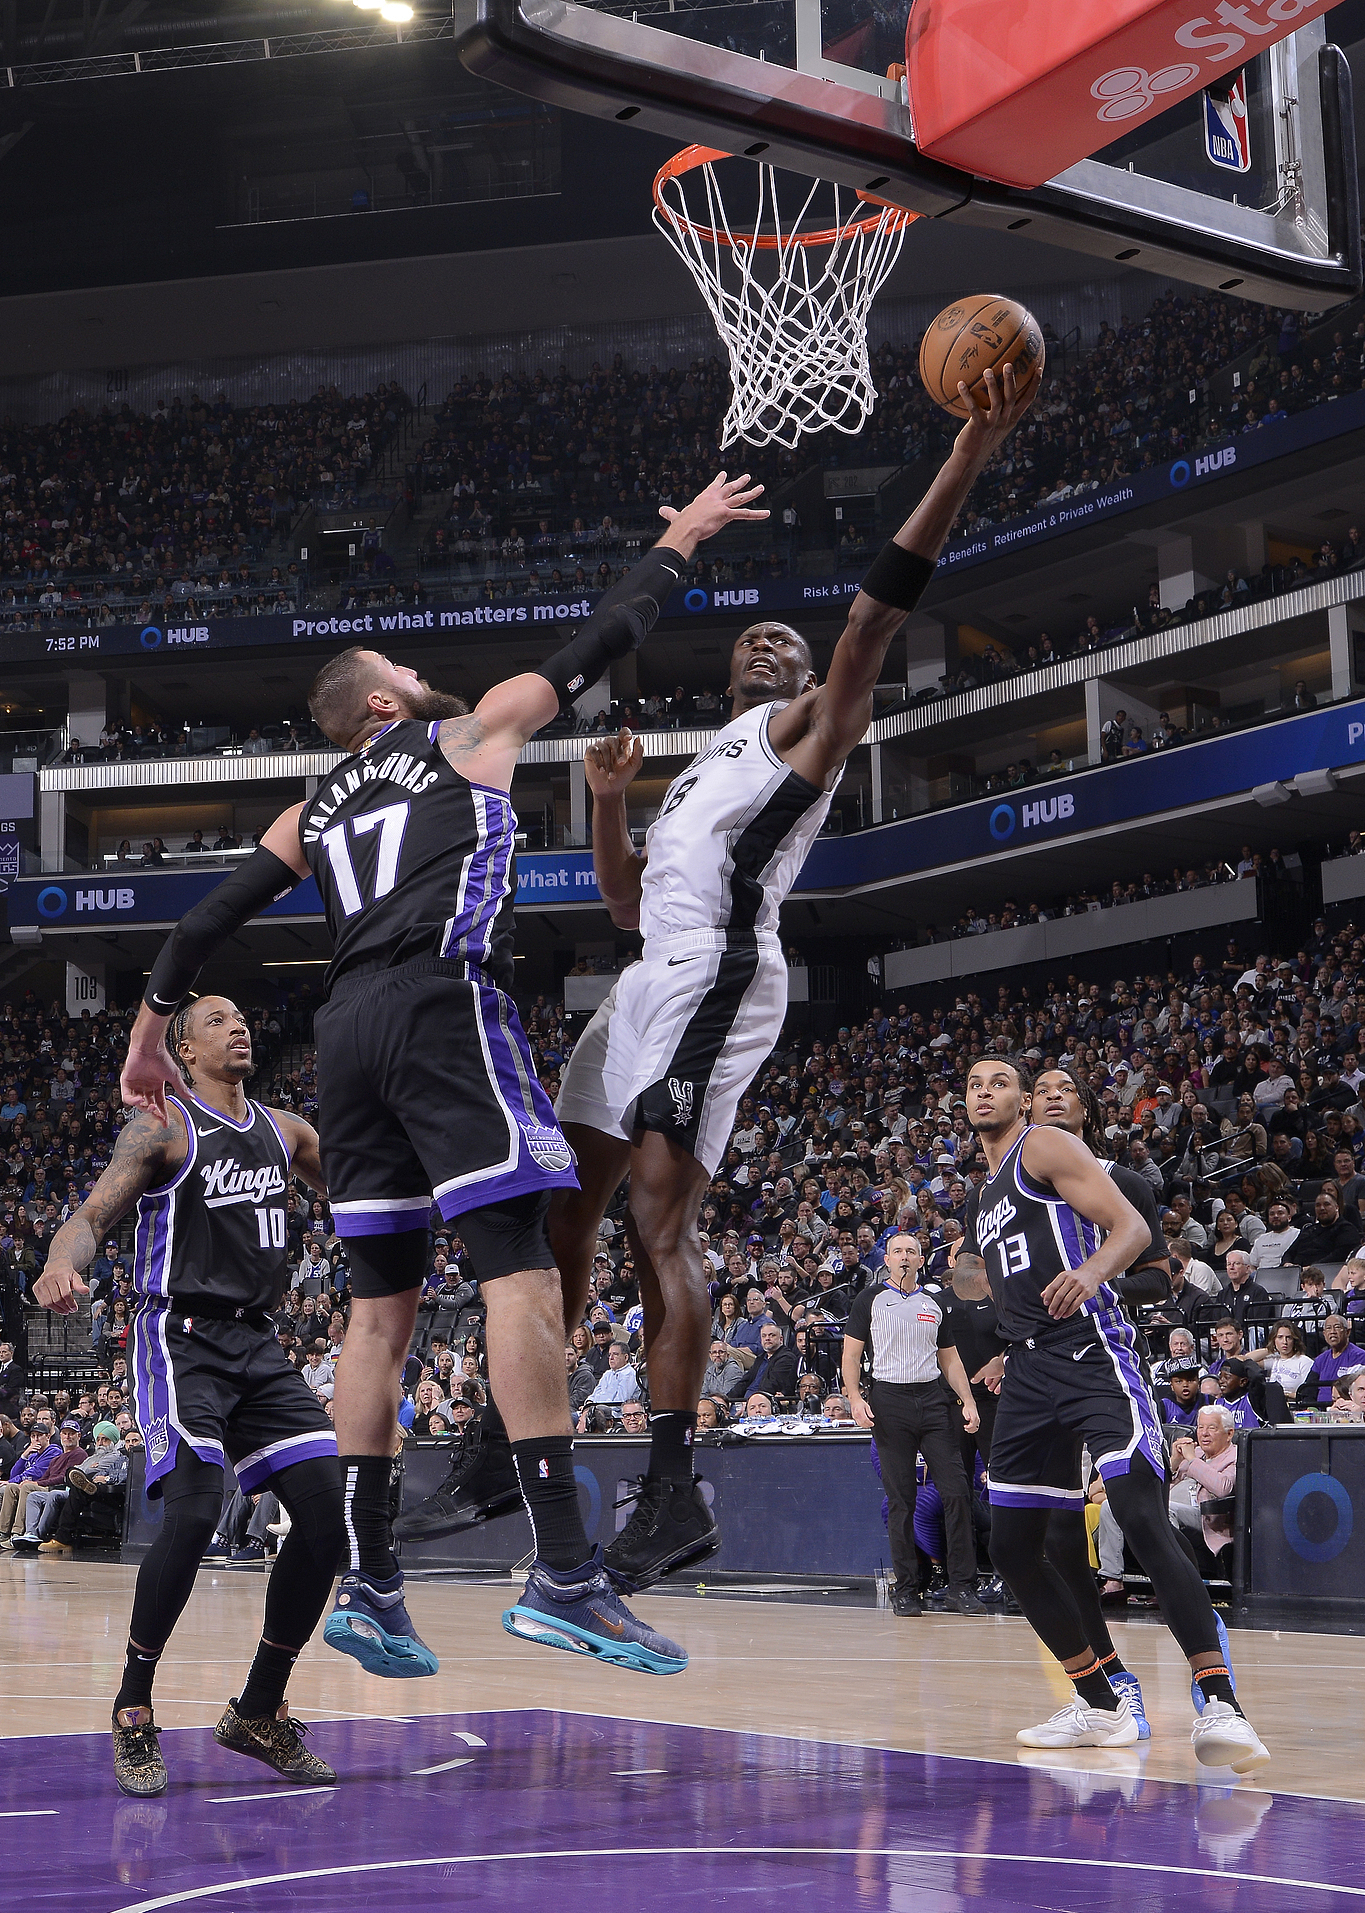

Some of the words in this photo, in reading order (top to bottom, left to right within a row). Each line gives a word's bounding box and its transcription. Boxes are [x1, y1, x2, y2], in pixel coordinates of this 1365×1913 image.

[1212, 134, 1235, 161] NBA
[1195, 446, 1237, 477] HUB
[994, 518, 1047, 547] Retirement
[1049, 514, 1057, 527] &
[1059, 502, 1094, 523] Private
[1096, 487, 1134, 509] Wealth
[949, 541, 987, 563] Benefits
[714, 589, 760, 607] HUB
[803, 586, 829, 599] Risk
[832, 584, 841, 596] &
[292, 615, 373, 637] Protect
[379, 610, 434, 631] what
[440, 606, 528, 627] matters
[45, 637, 75, 652] 7:52
[79, 635, 100, 649] PM
[167, 626, 210, 644] HUB
[1022, 793, 1075, 828] HUB
[320, 799, 411, 919] 17
[517, 869, 569, 889] what
[75, 888, 135, 911] HUB
[74, 976, 97, 1001] 103
[529, 1141, 568, 1153] KINGS
[200, 1158, 286, 1208] Kings
[254, 1208, 286, 1249] 10
[997, 1231, 1031, 1278] 13
